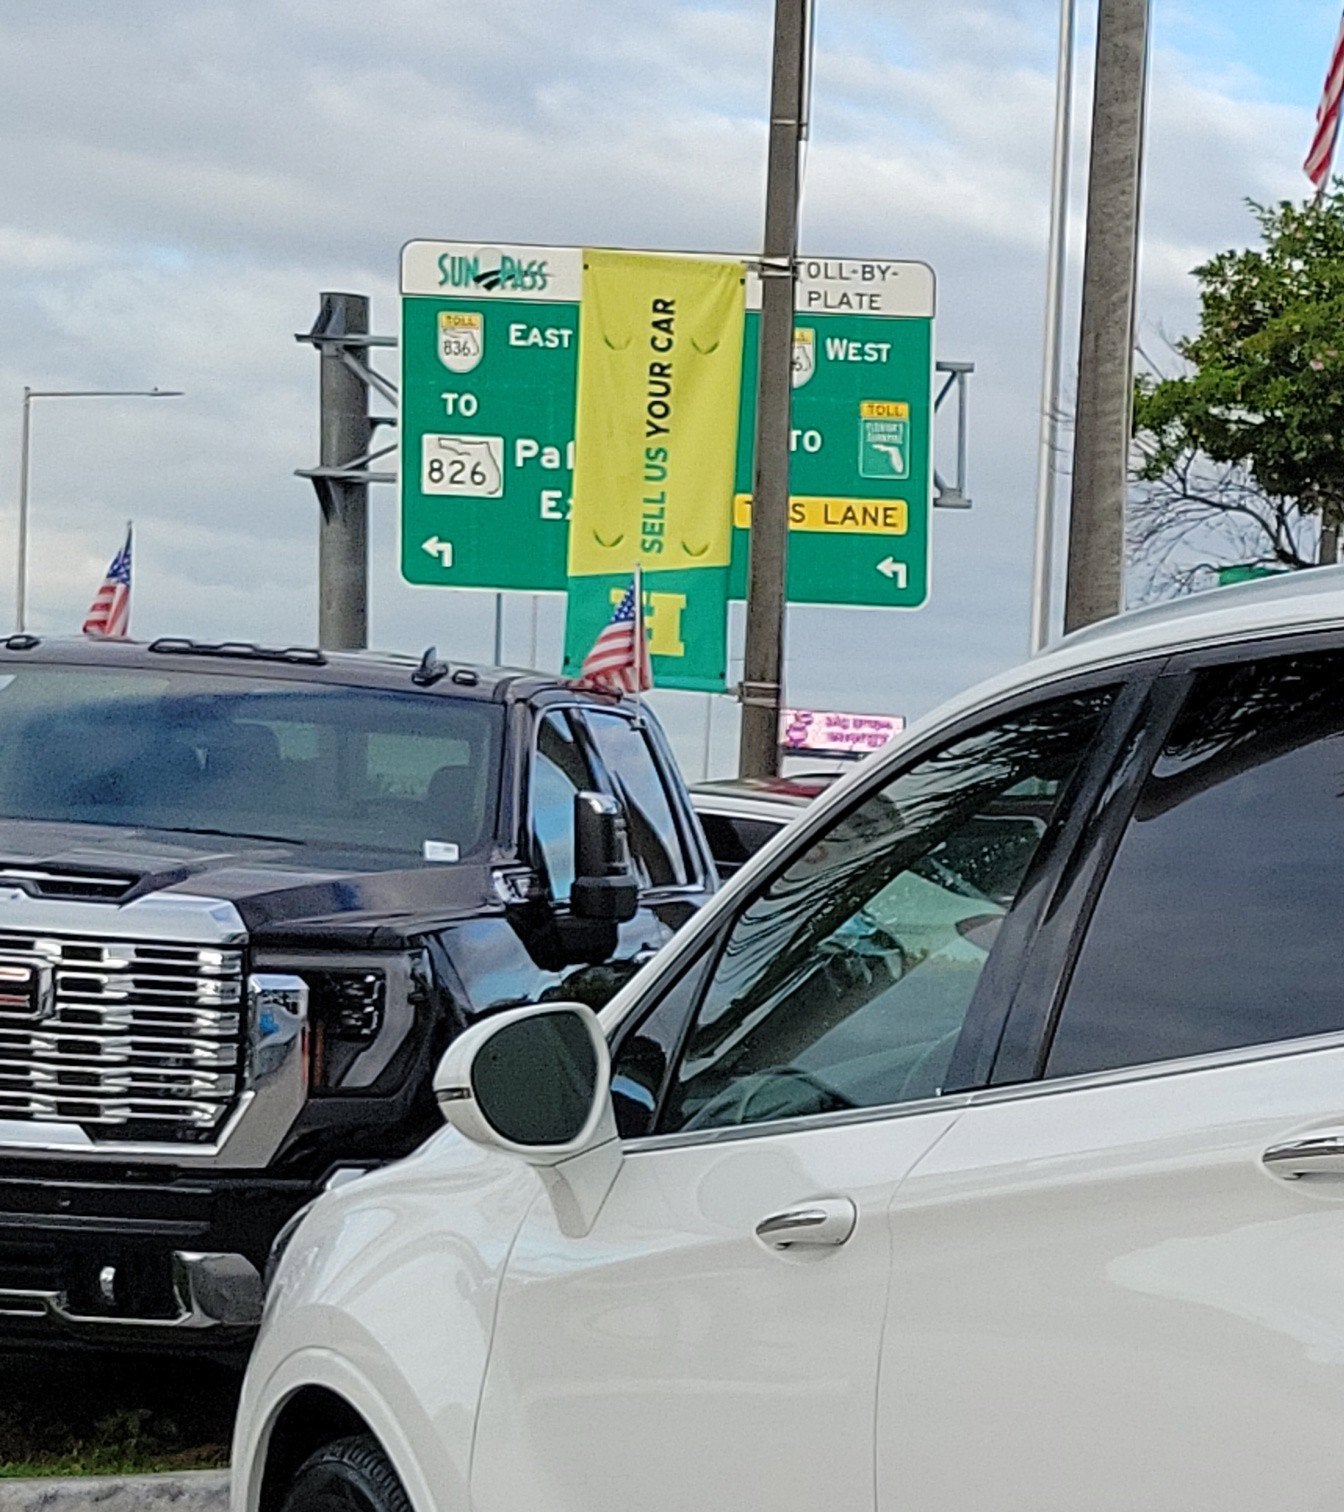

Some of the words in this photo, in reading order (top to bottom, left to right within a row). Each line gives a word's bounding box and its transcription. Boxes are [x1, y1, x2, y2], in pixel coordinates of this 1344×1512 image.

[807, 291, 882, 310] PLATE
[443, 340, 471, 356] 836
[509, 323, 573, 348] EAST
[650, 298, 676, 353] CAR
[825, 337, 891, 362] WEST
[441, 392, 478, 417] TO
[645, 361, 673, 438] YOUR
[867, 403, 904, 417] TOLL
[428, 458, 486, 486] 826
[643, 446, 668, 482] US
[640, 490, 666, 554] SELL
[823, 503, 898, 527] LANE
